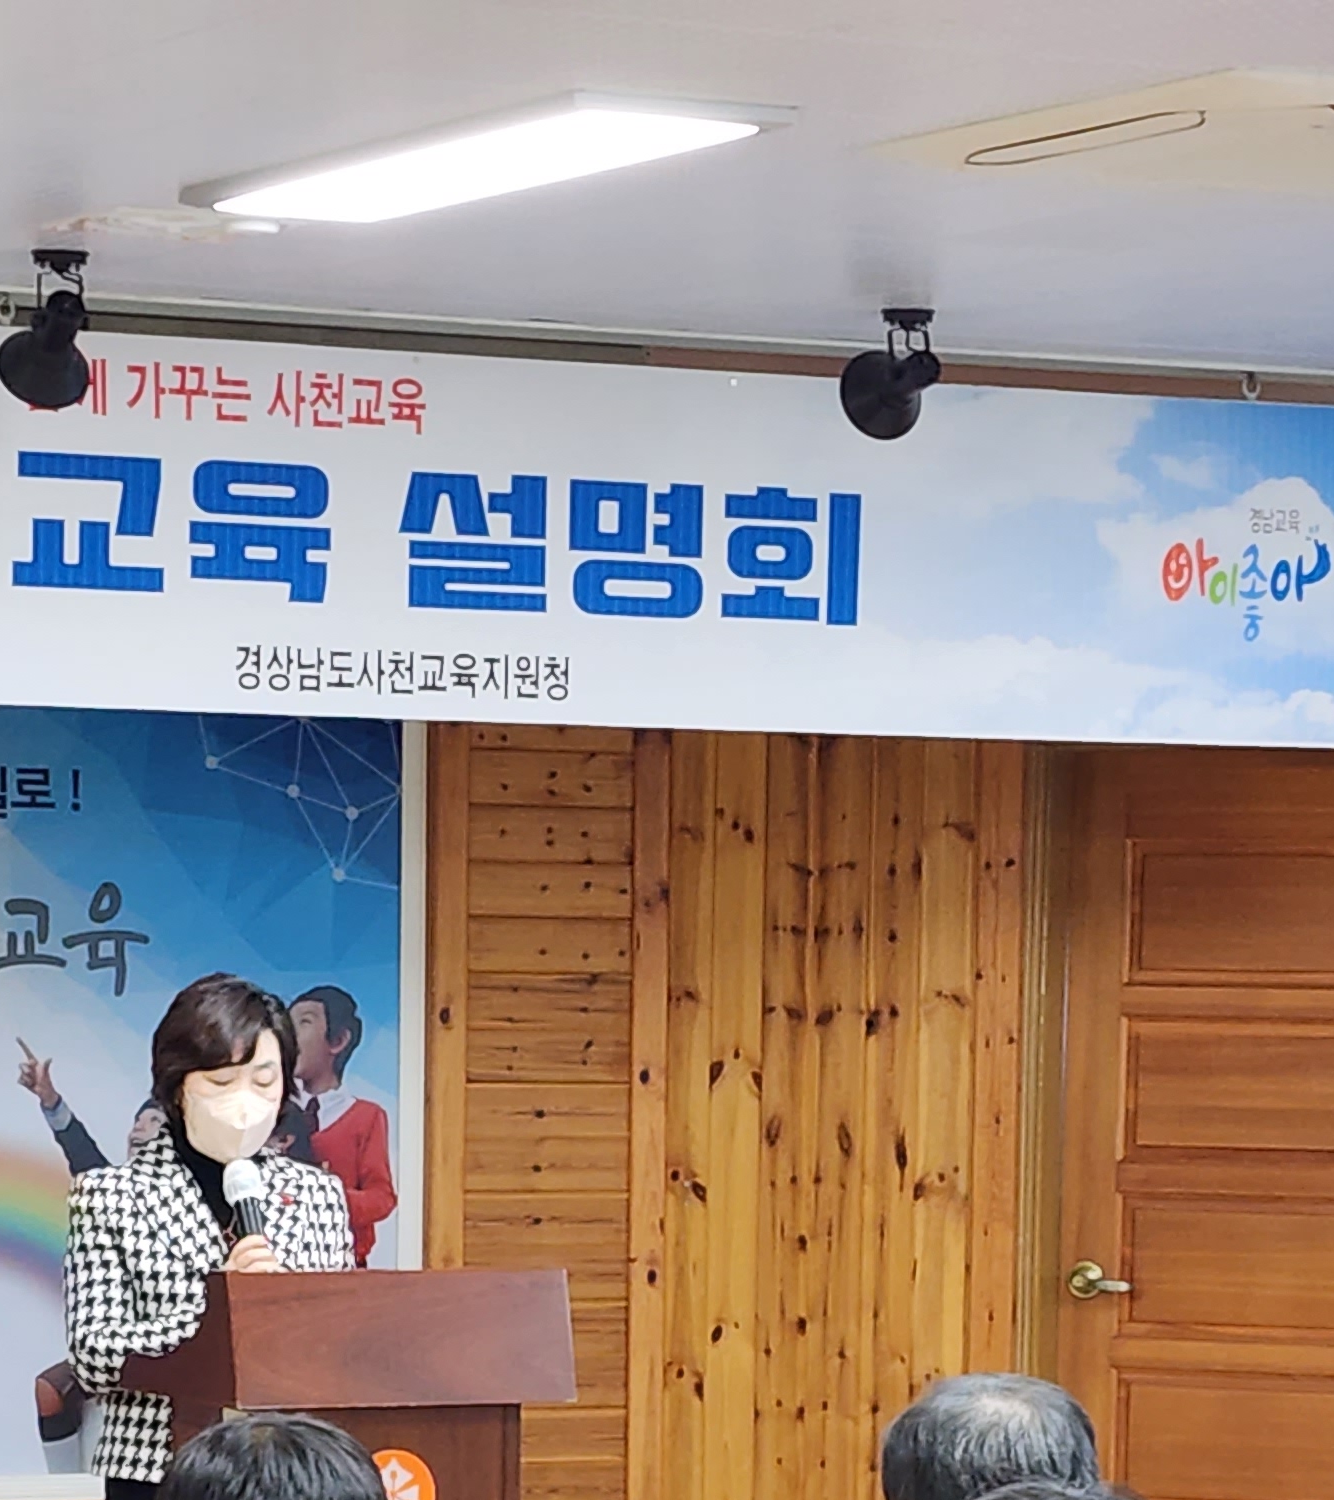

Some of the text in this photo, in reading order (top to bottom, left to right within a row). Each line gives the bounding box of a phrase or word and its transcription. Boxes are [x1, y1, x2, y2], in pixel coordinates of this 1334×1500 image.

[126, 360, 252, 423] 가꾸는
[267, 370, 427, 435] 사천교육
[399, 470, 862, 626] 설명회
[1249, 507, 1301, 534] 경남교육
[234, 645, 571, 701] 경상남도사천교육지원청
